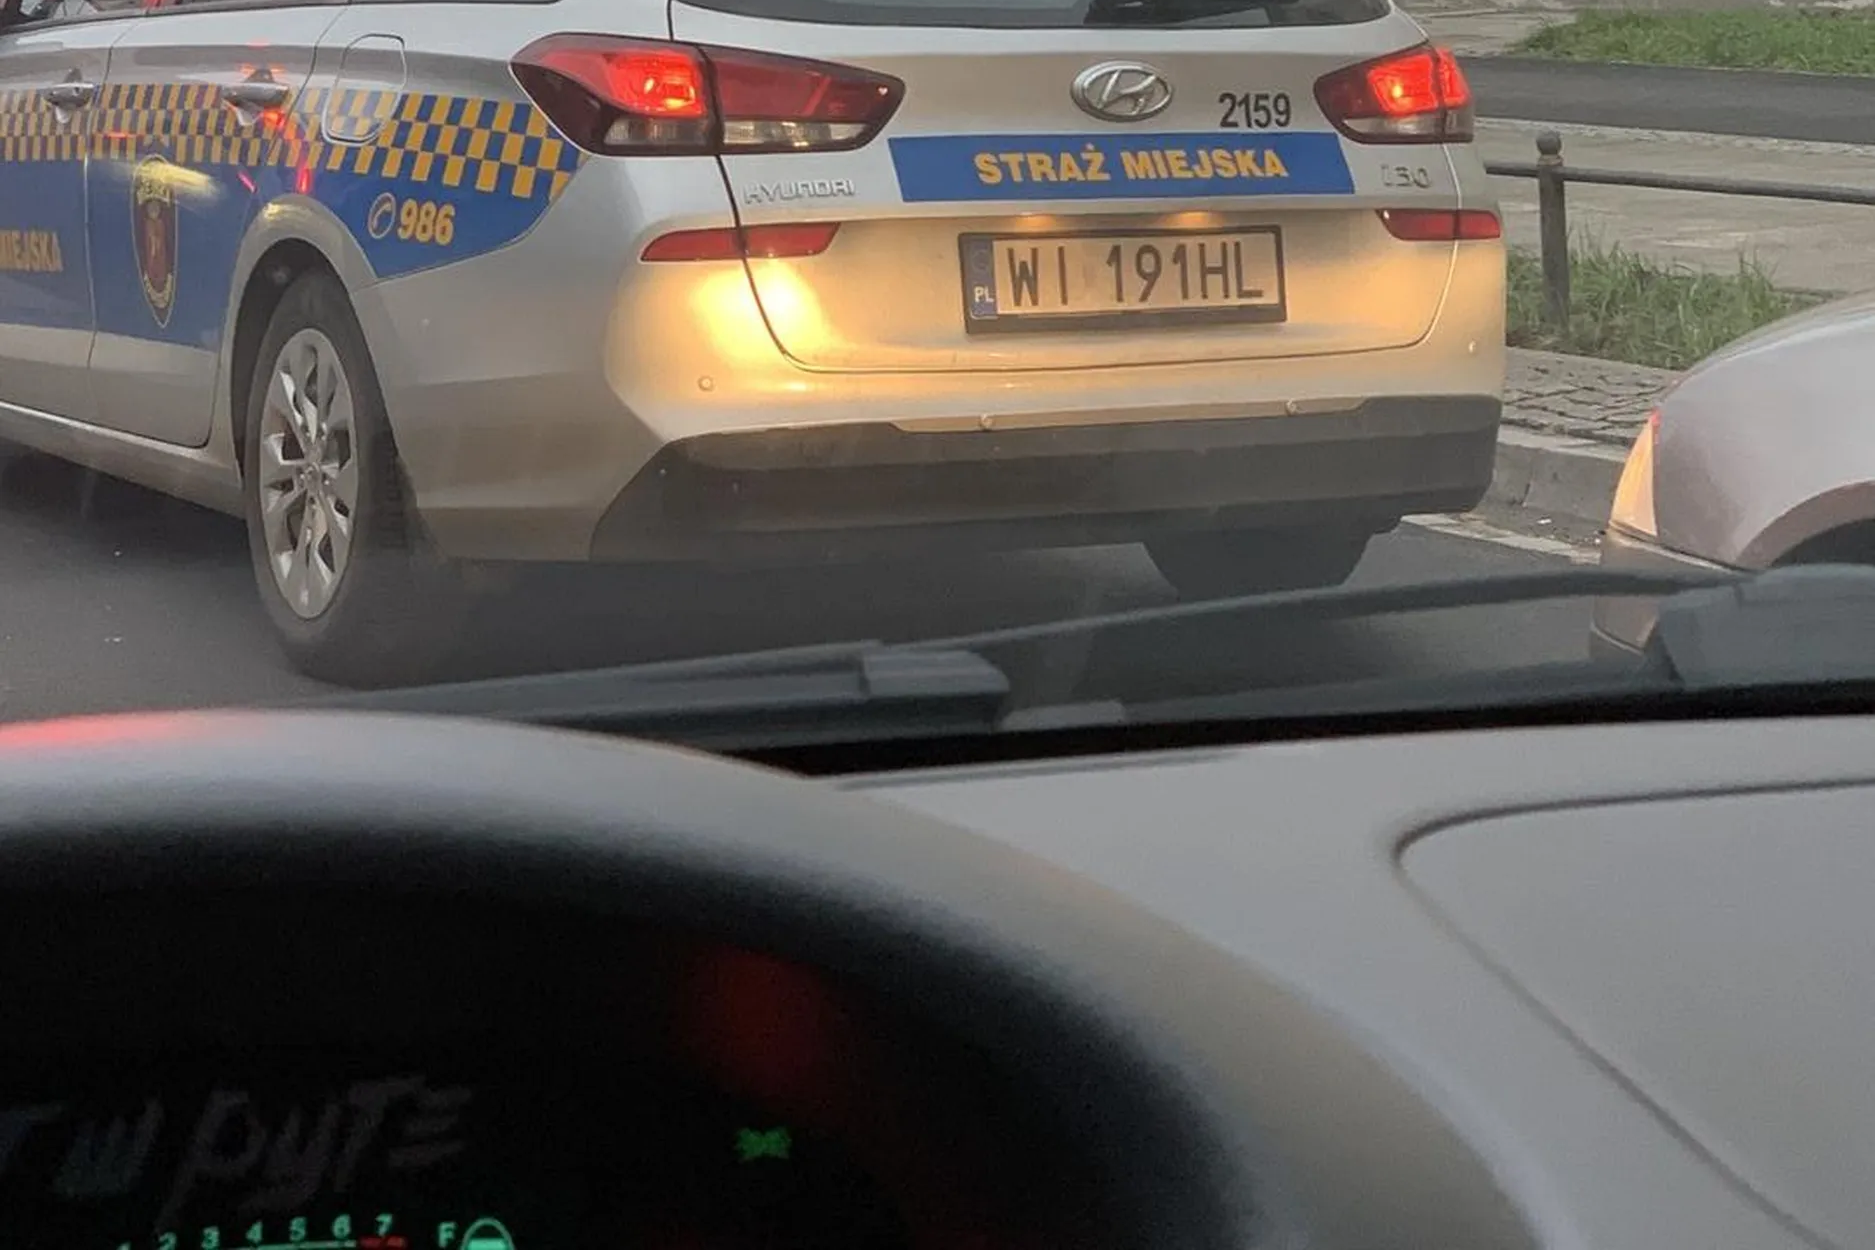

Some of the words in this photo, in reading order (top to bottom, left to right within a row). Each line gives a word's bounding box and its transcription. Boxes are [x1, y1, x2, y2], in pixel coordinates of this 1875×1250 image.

[1218, 93, 1292, 128] 2159
[973, 143, 1111, 185] STRAŻ
[1119, 149, 1289, 181] MIEJSKA
[743, 178, 857, 204] HYUNDAI
[397, 198, 457, 246] 986
[1007, 246, 1069, 307] WI
[1106, 241, 1264, 304] 191HL
[974, 286, 995, 304] PL
[202, 1225, 220, 1249] 3
[245, 1221, 263, 1243] 4
[288, 1216, 307, 1241] 5
[331, 1214, 351, 1237] 6
[374, 1213, 393, 1236] 7
[437, 1221, 457, 1247] F
